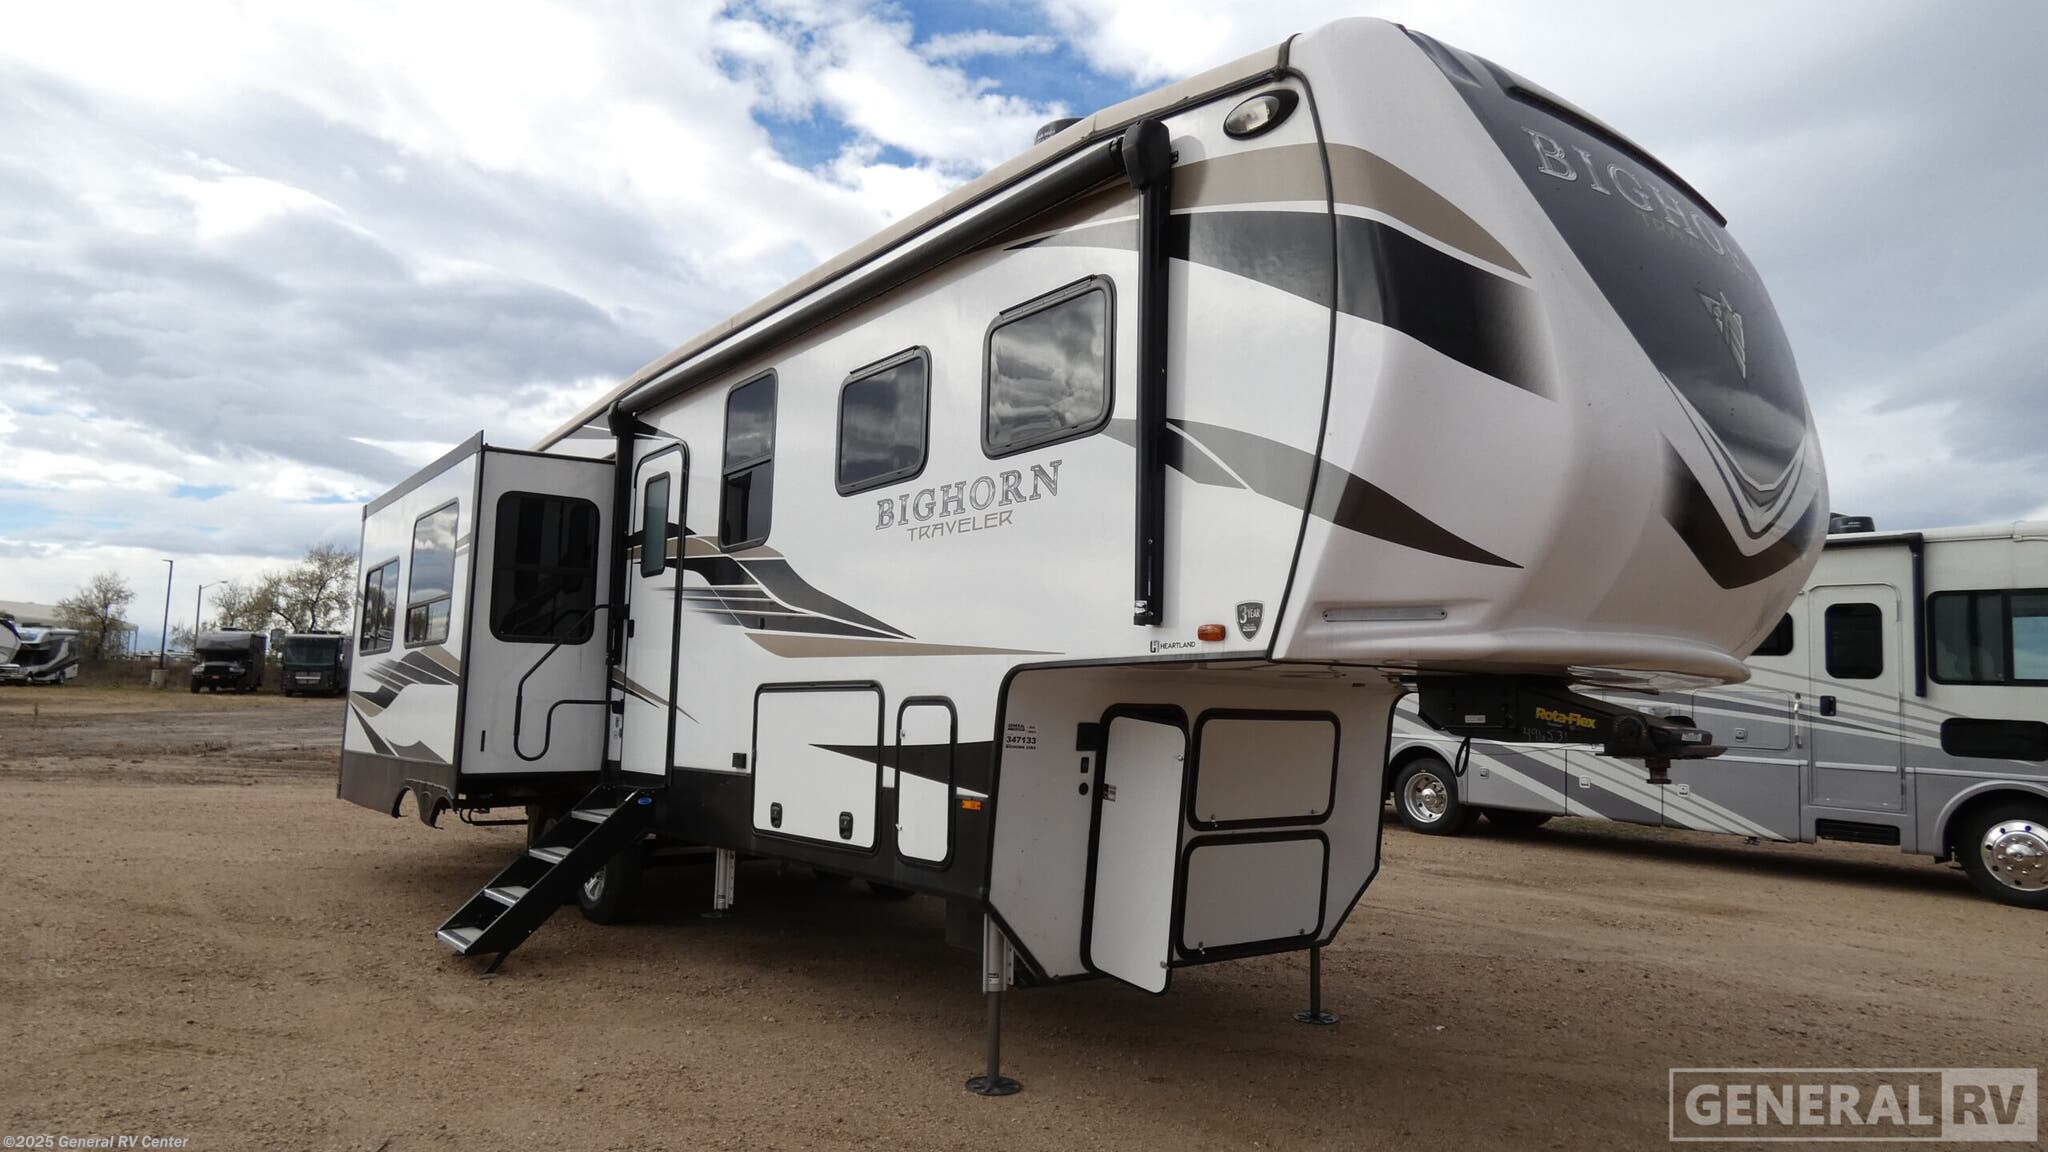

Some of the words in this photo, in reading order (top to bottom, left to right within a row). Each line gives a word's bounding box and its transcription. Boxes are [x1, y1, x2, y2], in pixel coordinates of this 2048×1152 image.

[1519, 126, 1752, 281] BIGHO
[875, 459, 1063, 530] BIGHORN
[907, 509, 1014, 542] TRAVELER
[1239, 605, 1248, 624] 3
[1160, 641, 1196, 650] HEARTLAND
[1535, 706, 1598, 729] Rota-Flex
[1006, 735, 1037, 745] 347133
